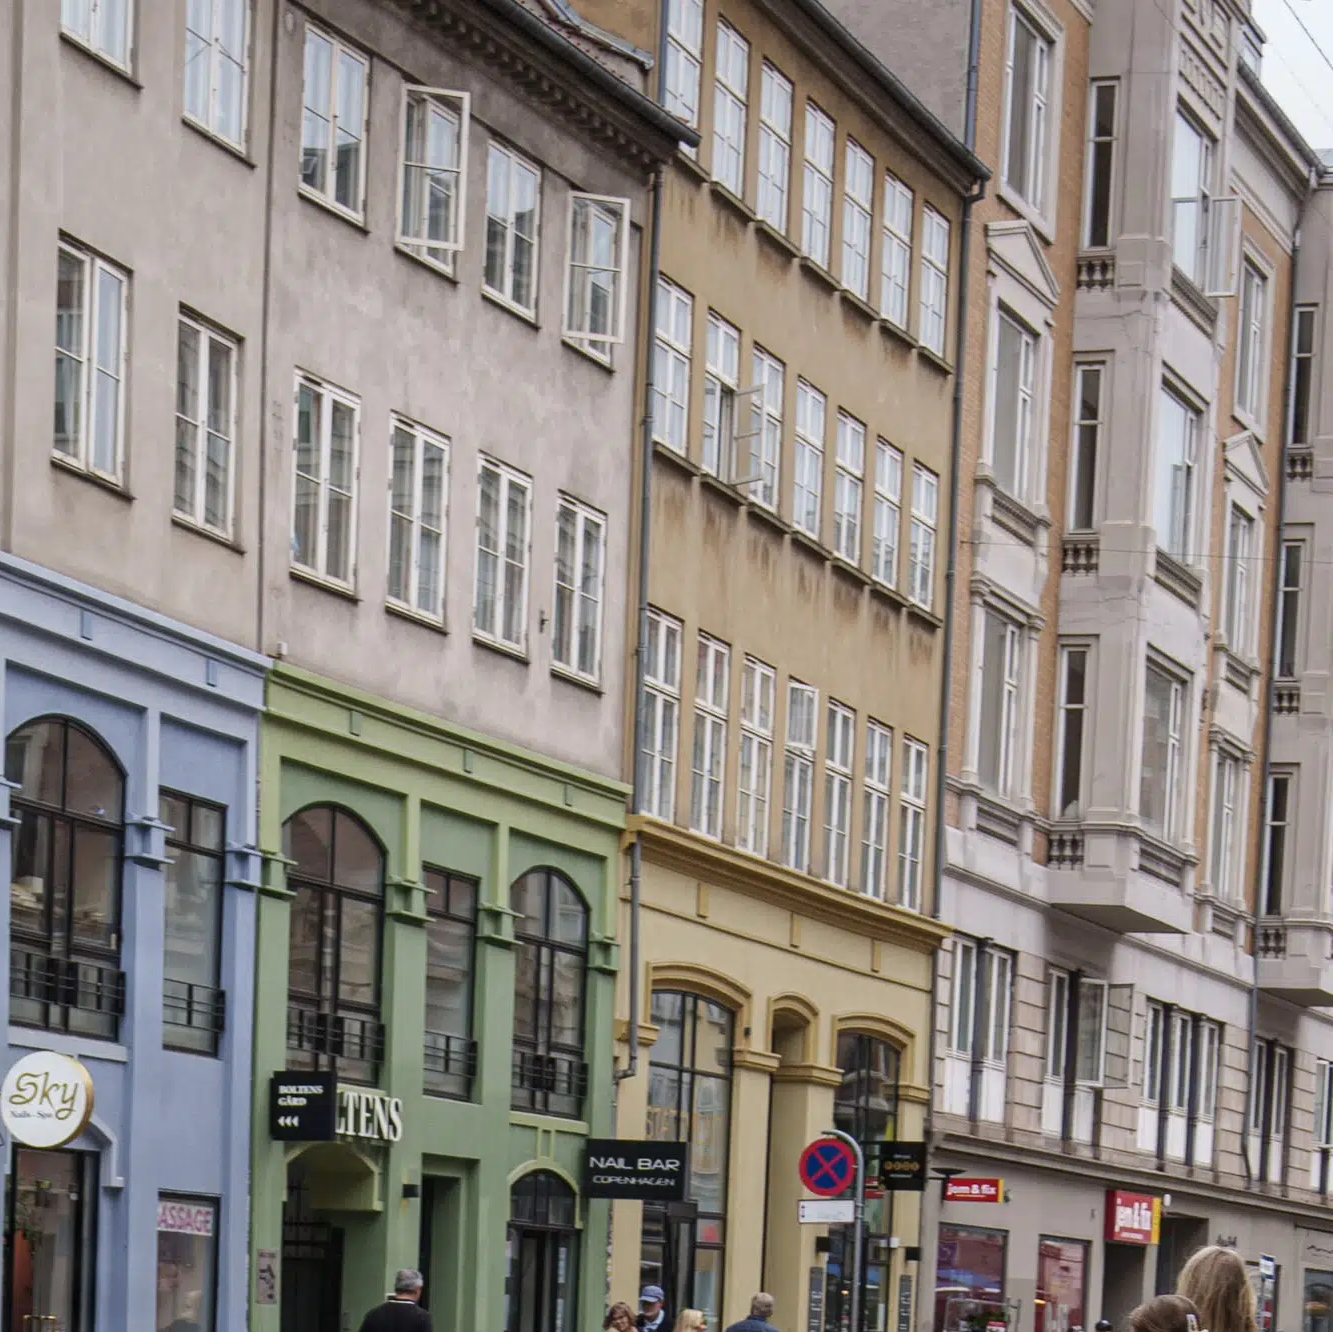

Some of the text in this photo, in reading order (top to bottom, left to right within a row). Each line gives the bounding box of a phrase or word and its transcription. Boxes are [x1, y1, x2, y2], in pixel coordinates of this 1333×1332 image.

[9, 1072, 79, 1120] Sky
[278, 1085, 324, 1095] BOLTENS
[277, 1095, 307, 1106] GÅRD
[335, 1090, 403, 1142] LTENS
[589, 1156, 681, 1171] NAIL BAR
[593, 1175, 675, 1187] COPENHAGEN
[157, 1202, 212, 1233] ASSAGE
